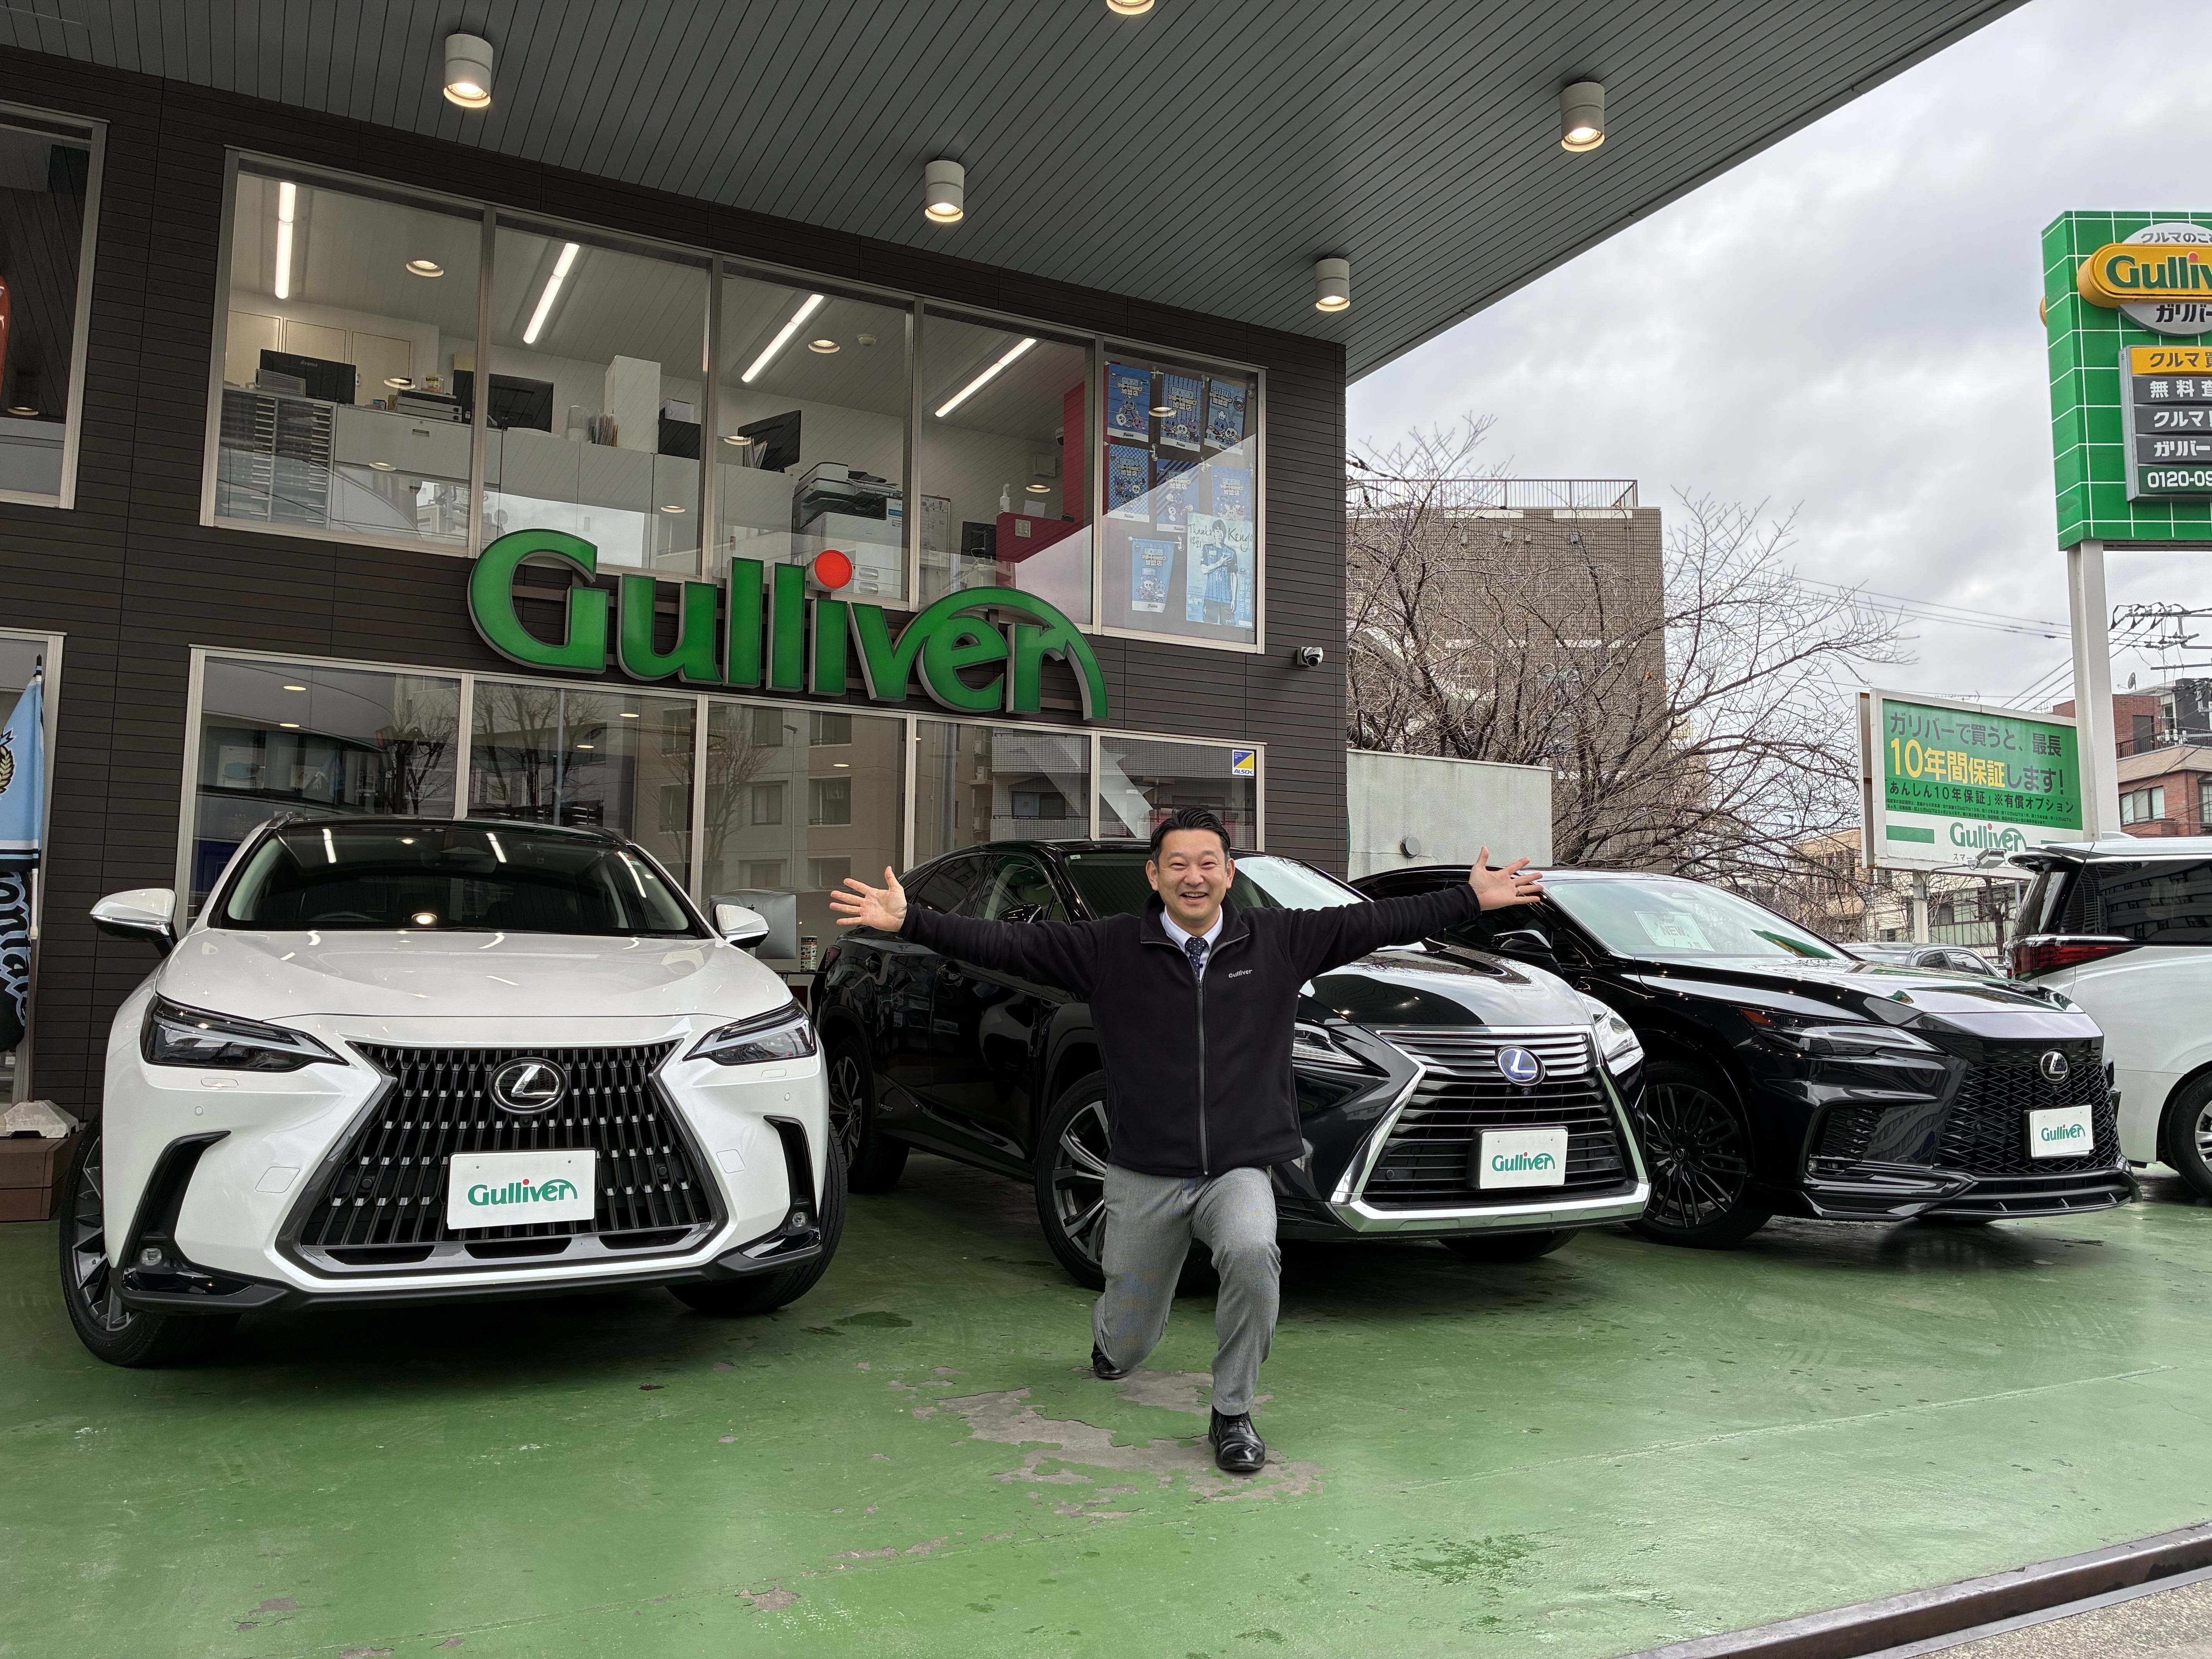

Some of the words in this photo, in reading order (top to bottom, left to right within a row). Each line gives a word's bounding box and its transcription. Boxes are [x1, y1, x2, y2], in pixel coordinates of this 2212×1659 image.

[468, 529, 1109, 720] Gulliver
[1950, 822, 2027, 852] Gulliver
[1953, 853, 1978, 861] スマー
[1659, 926, 1686, 936] NEW
[1228, 969, 1253, 978] Gulliver
[2041, 1124, 2086, 1142] Gulliver
[1492, 1152, 1555, 1171] Gulliver
[468, 1178, 578, 1206] Gulliver
